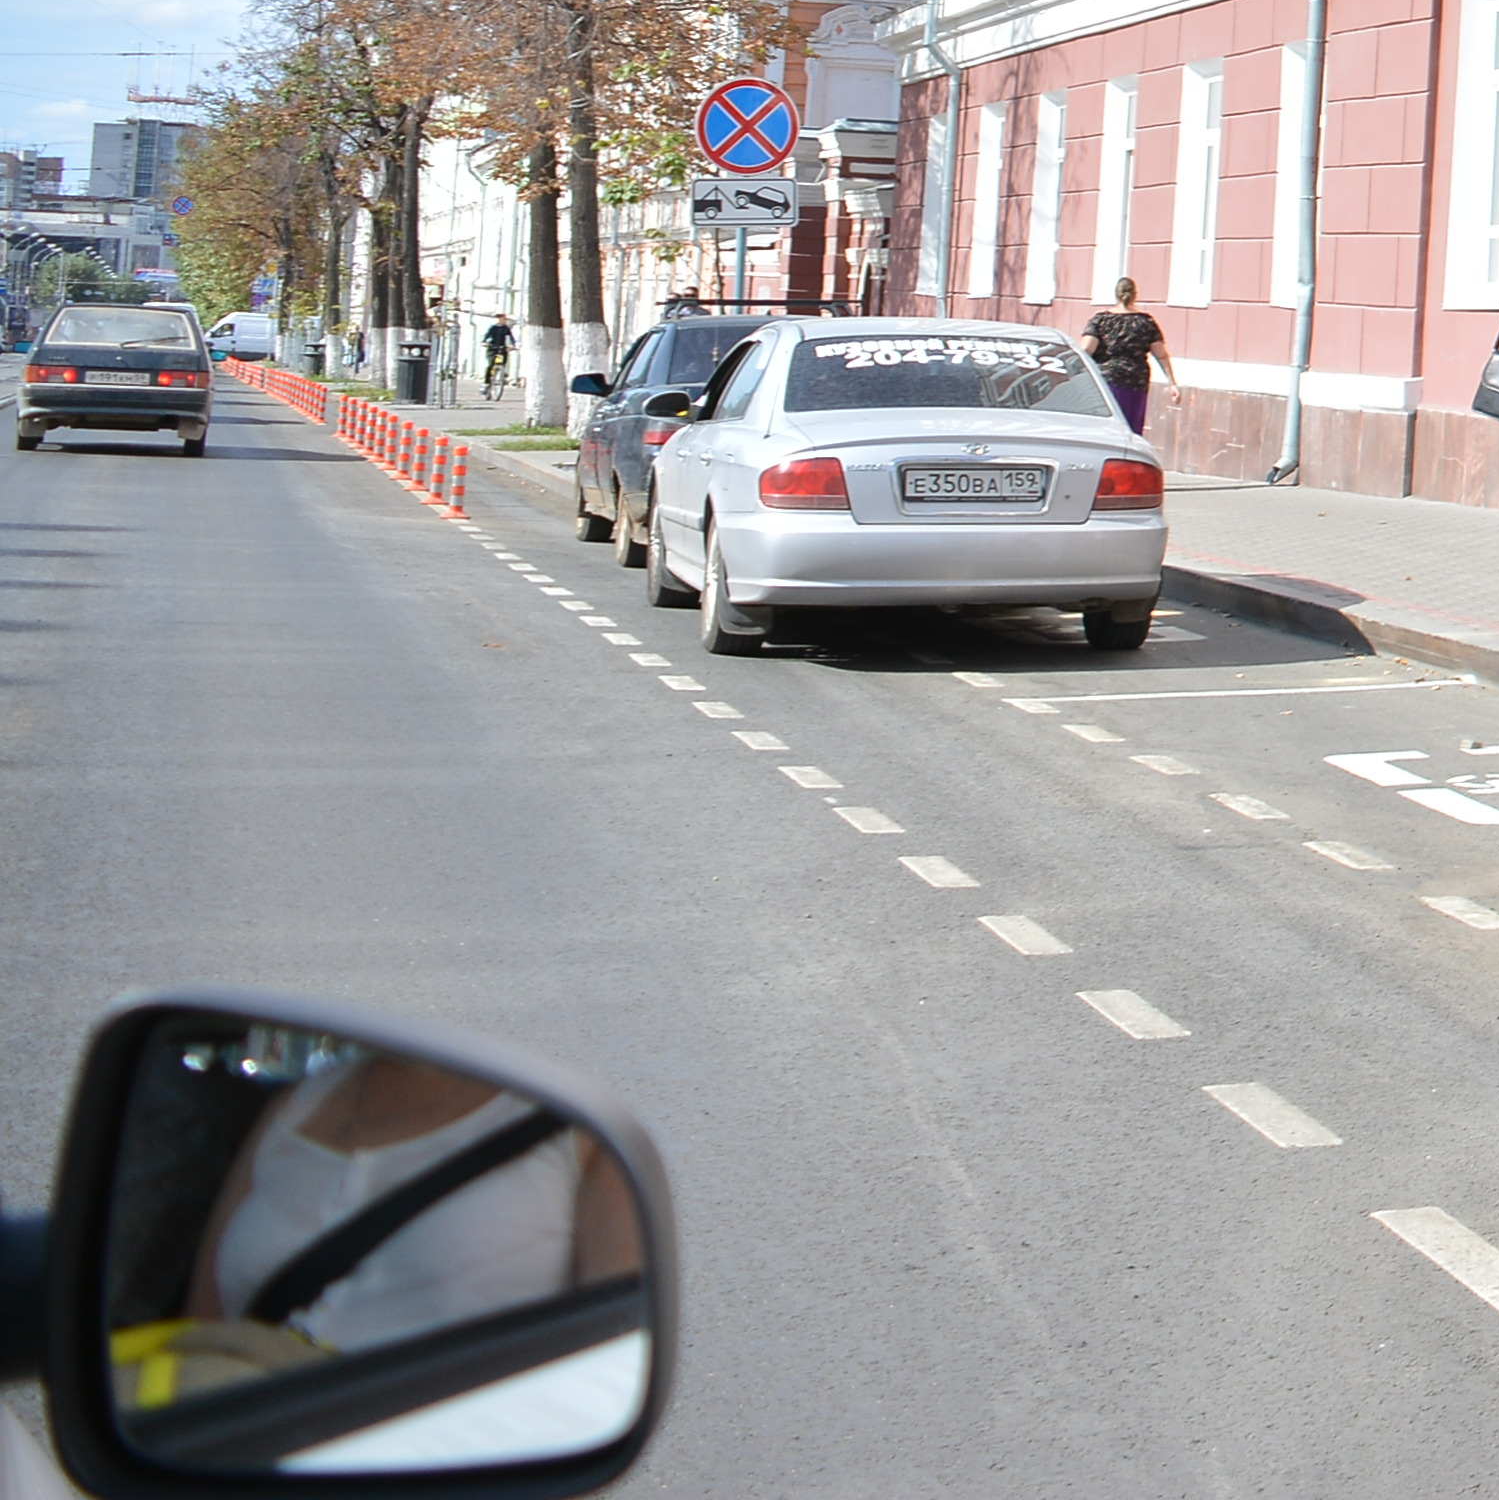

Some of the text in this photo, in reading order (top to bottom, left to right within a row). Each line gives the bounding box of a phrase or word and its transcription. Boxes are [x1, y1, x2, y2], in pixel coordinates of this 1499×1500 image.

[845, 347, 1068, 374] 204-79-32
[914, 472, 1037, 493] Е350ВА 159
